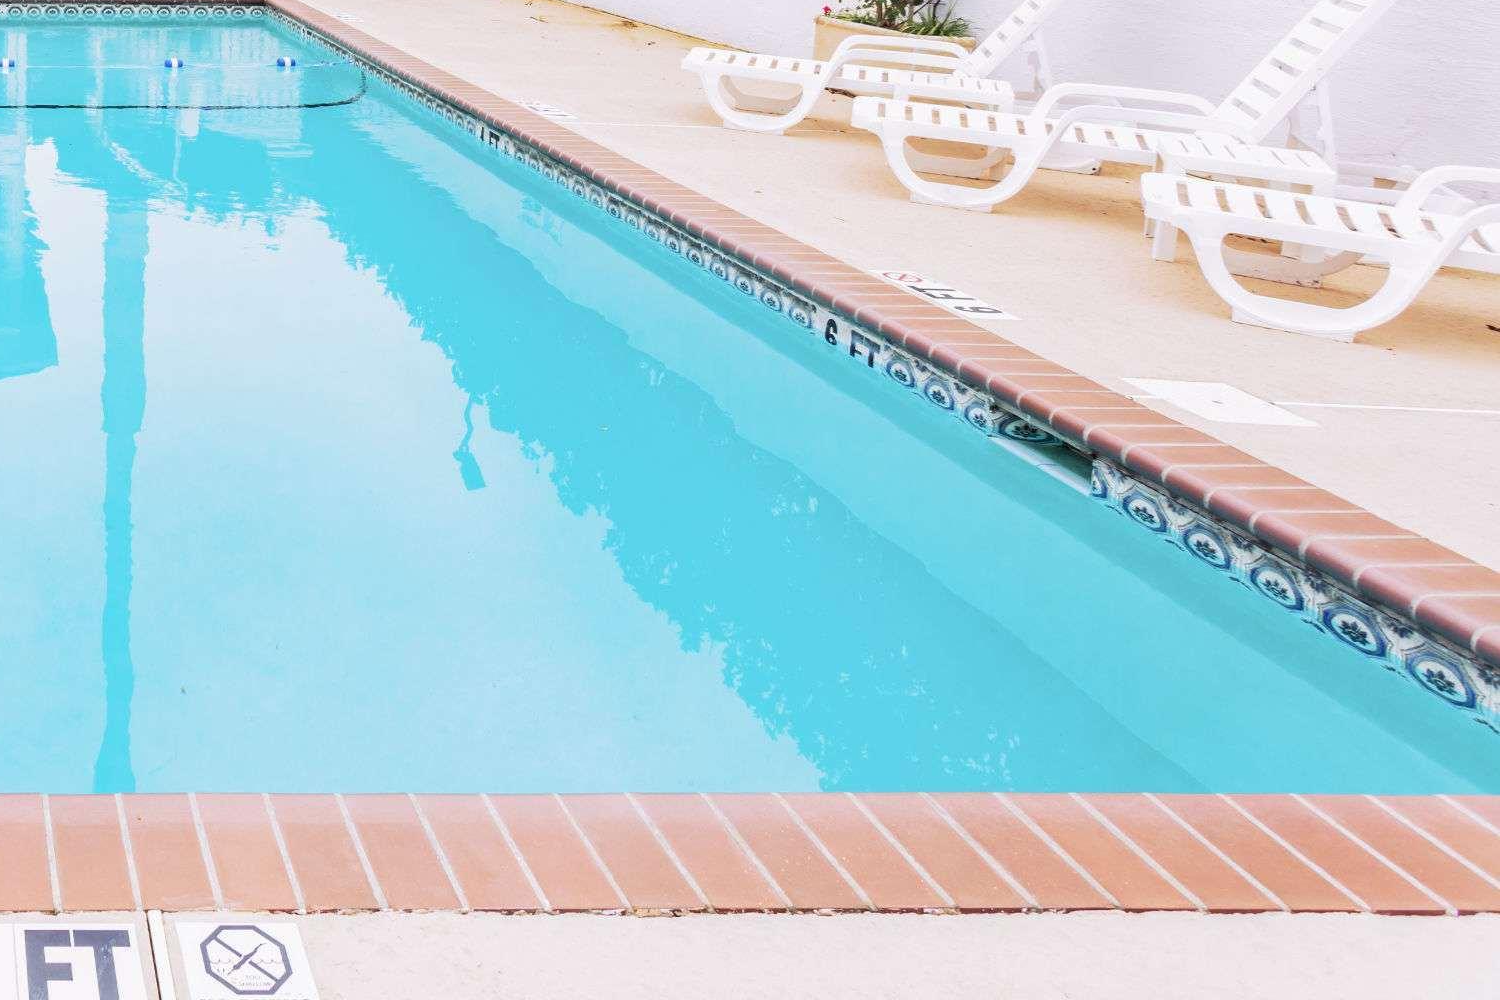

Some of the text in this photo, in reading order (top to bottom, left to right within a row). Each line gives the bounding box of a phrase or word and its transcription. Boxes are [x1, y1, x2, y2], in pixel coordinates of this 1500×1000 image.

[907, 285, 1004, 315] 6 FT
[825, 318, 881, 369] 6 FT
[24, 929, 131, 1000] FT
